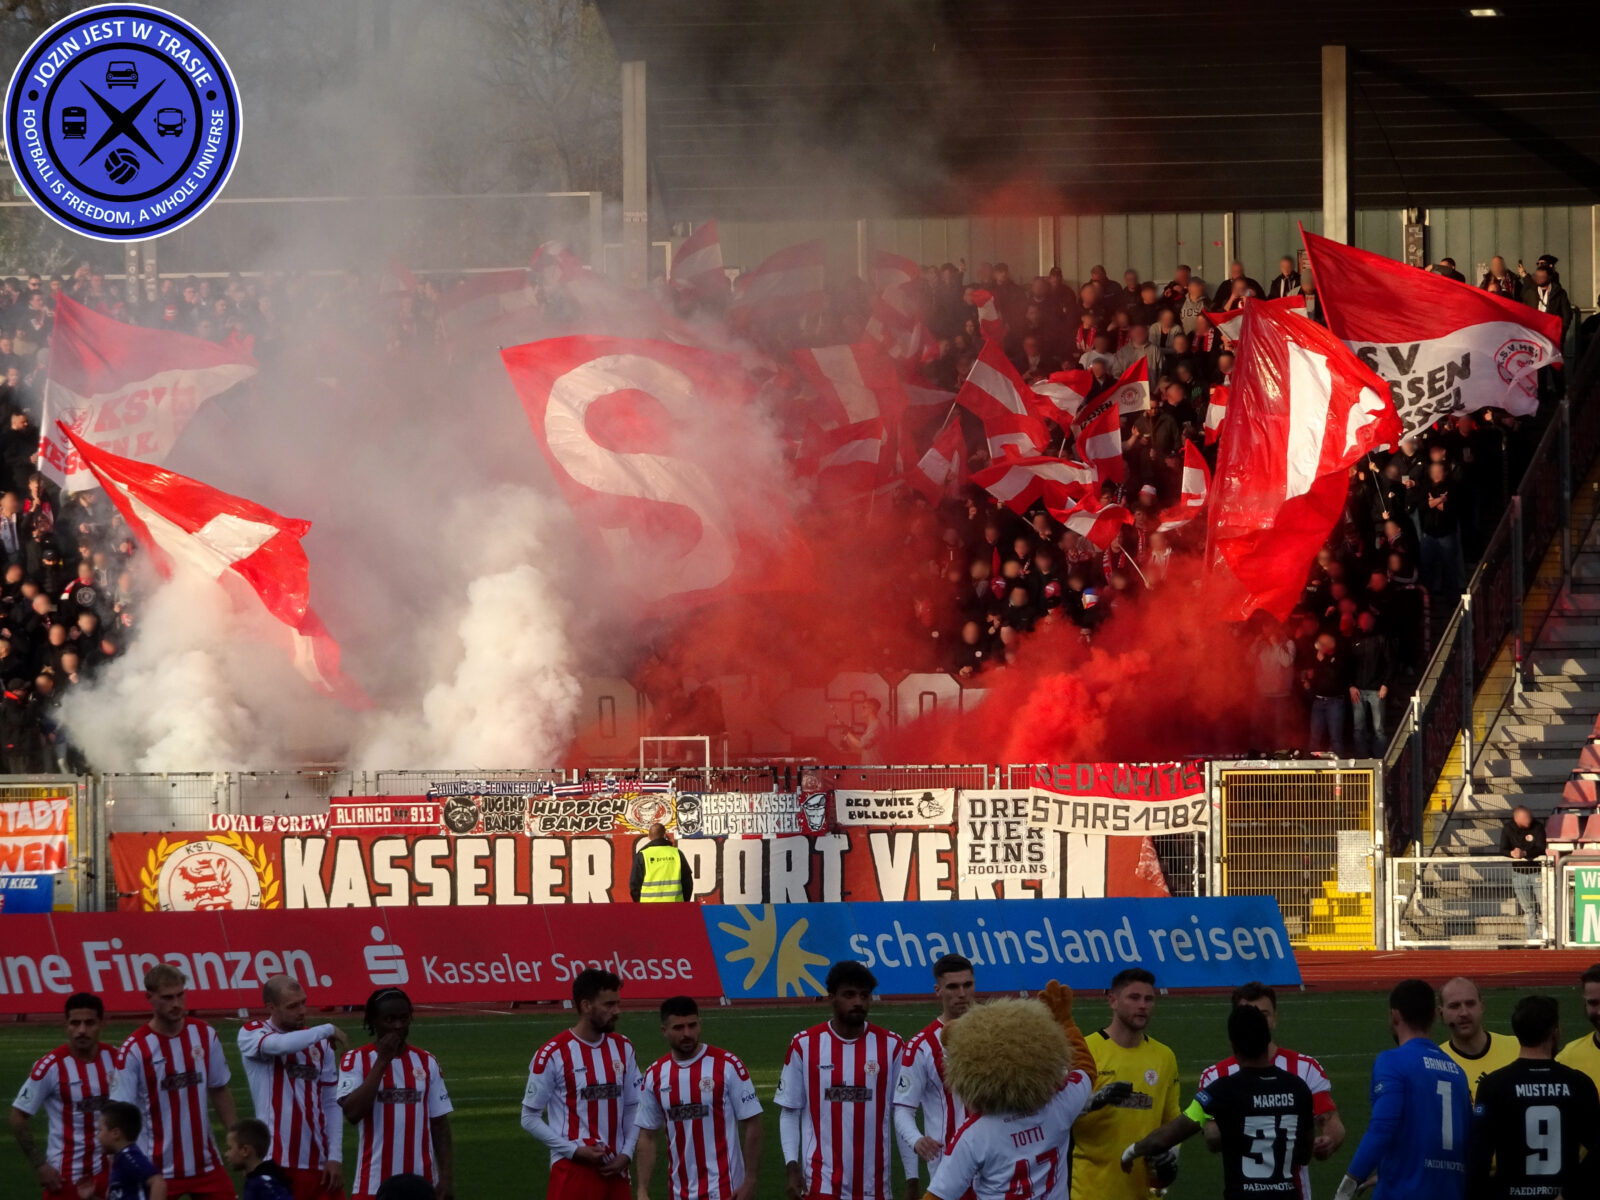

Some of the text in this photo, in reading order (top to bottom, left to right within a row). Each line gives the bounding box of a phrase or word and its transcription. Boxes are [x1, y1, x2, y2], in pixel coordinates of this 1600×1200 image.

[436, 782, 545, 796] YOUNG CONNECTION
[481, 796, 526, 813] JUGEND
[531, 799, 629, 816] HUDDICH
[701, 793, 801, 814] HESSEN KASSEL
[846, 797, 915, 807] RED WHITE
[0, 800, 68, 834] TADT
[208, 812, 331, 832] LOYAL CREW
[336, 807, 434, 824] ALIANCO 913
[484, 814, 525, 833] BANDE
[848, 809, 914, 820] BULLDOGS
[1031, 796, 1208, 831] STARS 1982
[540, 815, 614, 833] BANDE
[702, 813, 801, 835] HOLSTEIN KIEL
[968, 821, 1044, 840] VIER
[968, 842, 1045, 863] EINS
[281, 829, 1108, 908] KASSELER PORT VEIN
[967, 864, 1047, 875] HOOLIGANS
[9, 878, 39, 889] KIEL
[849, 916, 1285, 968] schauinsland reisen
[82, 937, 333, 995] Finanzen.
[421, 952, 543, 984] Kasseler
[551, 951, 693, 982] Sparkasse
[1253, 1093, 1295, 1108] MARCOS
[1515, 1083, 1571, 1098] MUSTAFA
[1436, 1080, 1453, 1150] 1
[1010, 1126, 1044, 1148] TOTTI
[1242, 1114, 1299, 1179] 31
[1525, 1105, 1561, 1175] 9
[1004, 1147, 1058, 1200] 47
